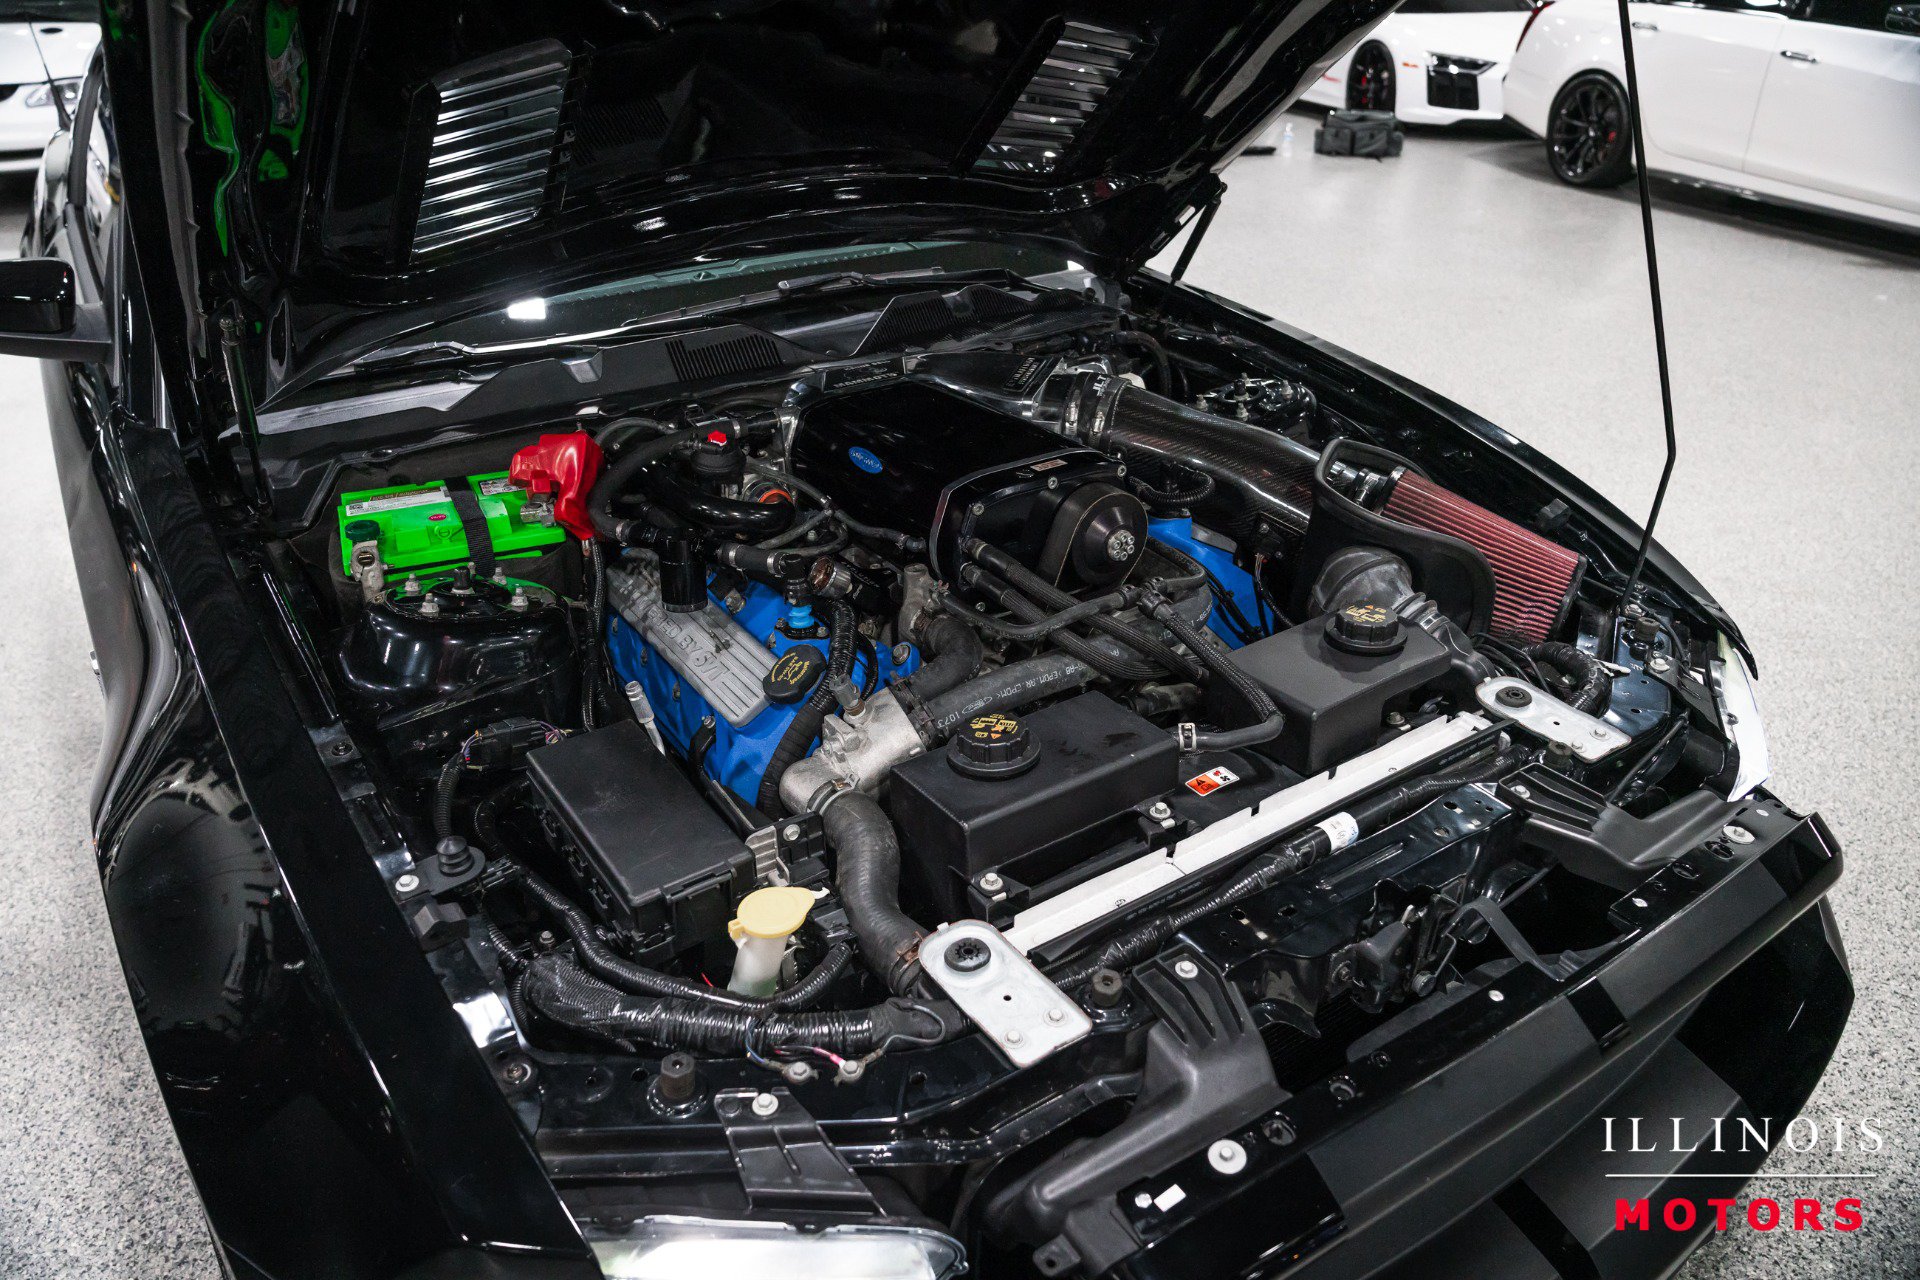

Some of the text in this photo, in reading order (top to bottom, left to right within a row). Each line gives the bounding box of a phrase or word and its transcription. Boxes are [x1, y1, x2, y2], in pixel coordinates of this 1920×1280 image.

[677, 632, 703, 659] BY
[691, 647, 729, 682] SVT
[937, 712, 960, 729] 1073
